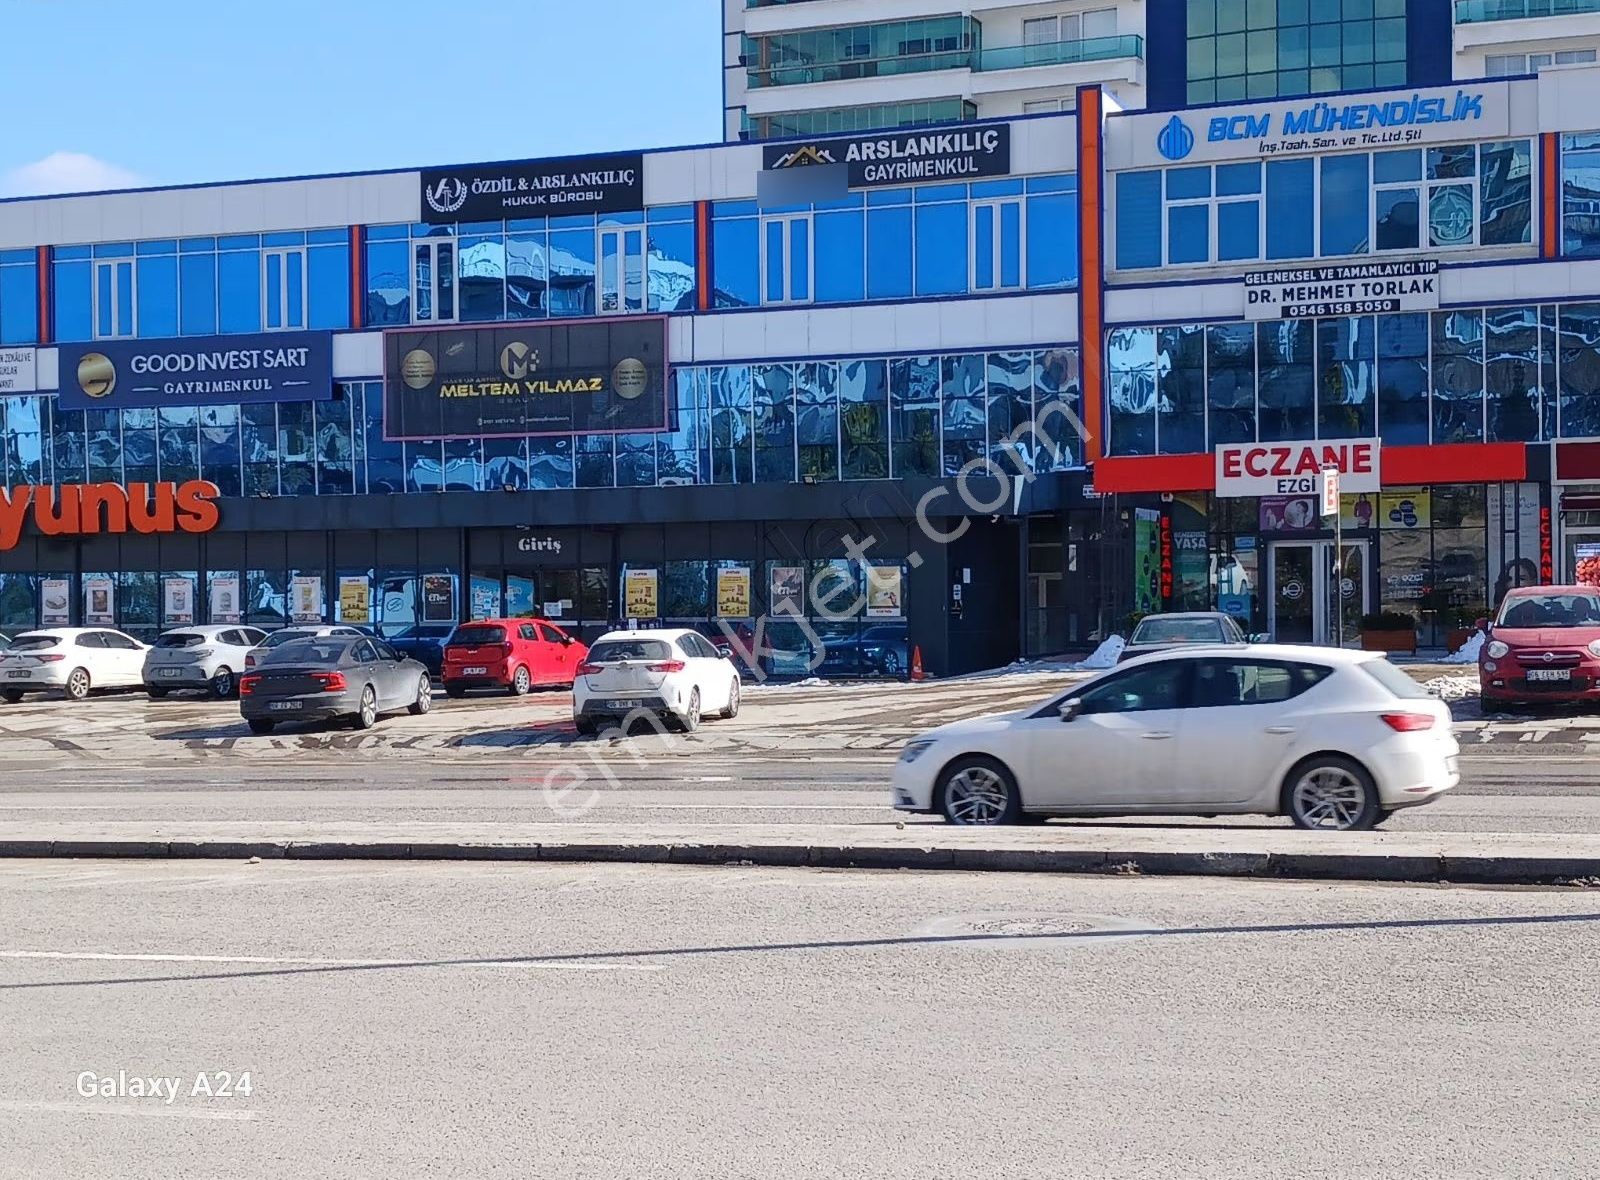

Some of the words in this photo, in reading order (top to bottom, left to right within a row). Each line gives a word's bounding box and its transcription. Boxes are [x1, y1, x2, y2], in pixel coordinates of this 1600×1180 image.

[1207, 113, 1271, 142] BCM
[1282, 90, 1484, 136] MÜHENDİSLİK
[845, 130, 999, 162] ARSLANKILIÇ
[1342, 137, 1356, 146] ve
[864, 156, 979, 181] GAYRİMENKUL
[471, 176, 516, 195] ÖZDİL
[517, 178, 529, 191] &
[530, 169, 635, 190] ARSLANKILIÇ
[502, 195, 546, 207] HUKUK
[550, 190, 604, 204] BÜROSU
[1245, 269, 1317, 285] GELENEKSEL
[1319, 269, 1334, 280] VE
[1337, 263, 1415, 278] TAMAMLAYICI
[1418, 262, 1437, 274] TIP
[1248, 289, 1277, 304] DR.
[1282, 283, 1356, 302] MEHMET
[1361, 278, 1434, 297] TORLAK
[1289, 304, 1325, 316] 0546
[1329, 302, 1351, 314] 158
[1355, 300, 1392, 313] 5050
[262, 348, 309, 369] SART
[440, 381, 520, 398] MELTEM
[525, 377, 603, 394] YILMAZ
[1223, 444, 1372, 478] ECZANE
[1277, 475, 1316, 493] EZGİ
[0, 480, 220, 551] yunus
[518, 537, 562, 554] Giriş
[1161, 517, 1172, 597] ECZANE
[1541, 507, 1552, 586] ECZAN
